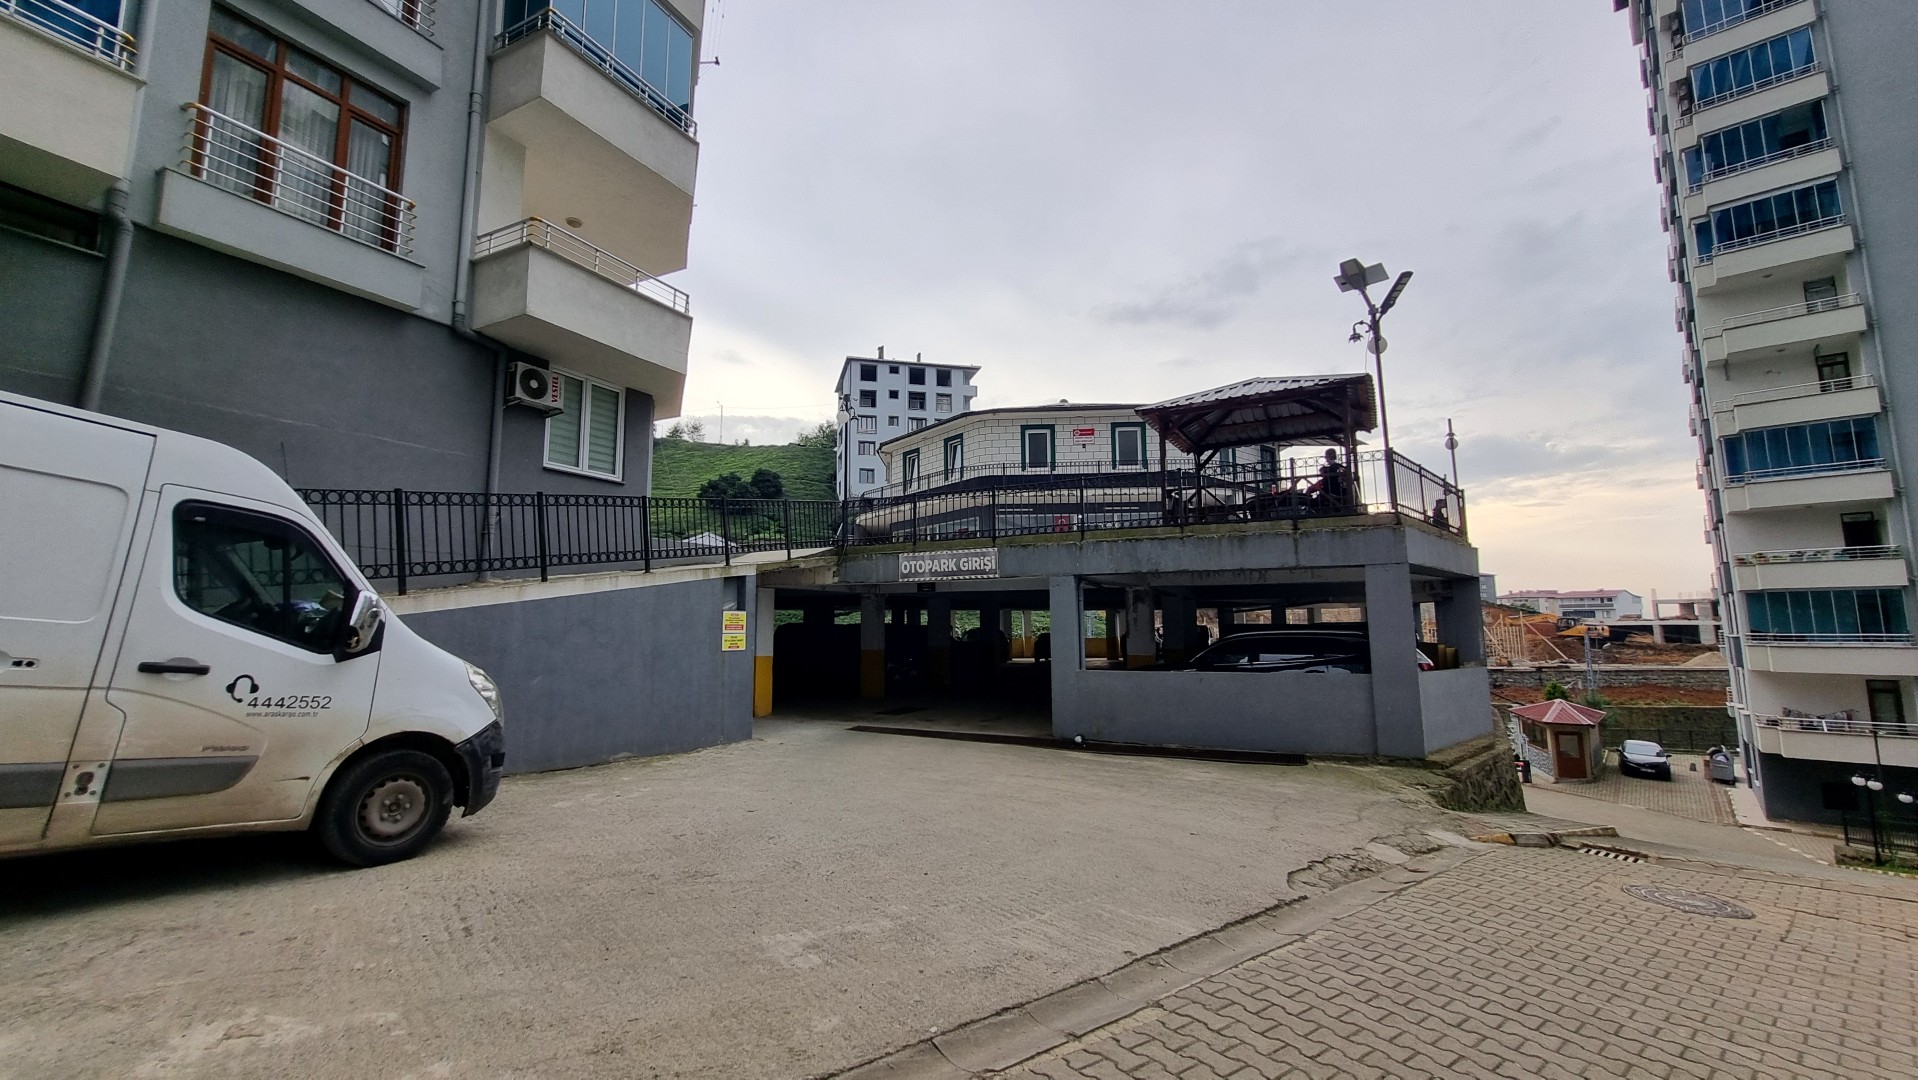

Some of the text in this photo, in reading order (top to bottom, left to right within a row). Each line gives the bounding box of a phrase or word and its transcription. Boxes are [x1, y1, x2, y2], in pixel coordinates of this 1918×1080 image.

[551, 376, 559, 403] VESTEL
[901, 558, 957, 574] OTOPARK
[247, 695, 332, 710] 4442552
[246, 710, 319, 718] www.araskargo.com.tr
